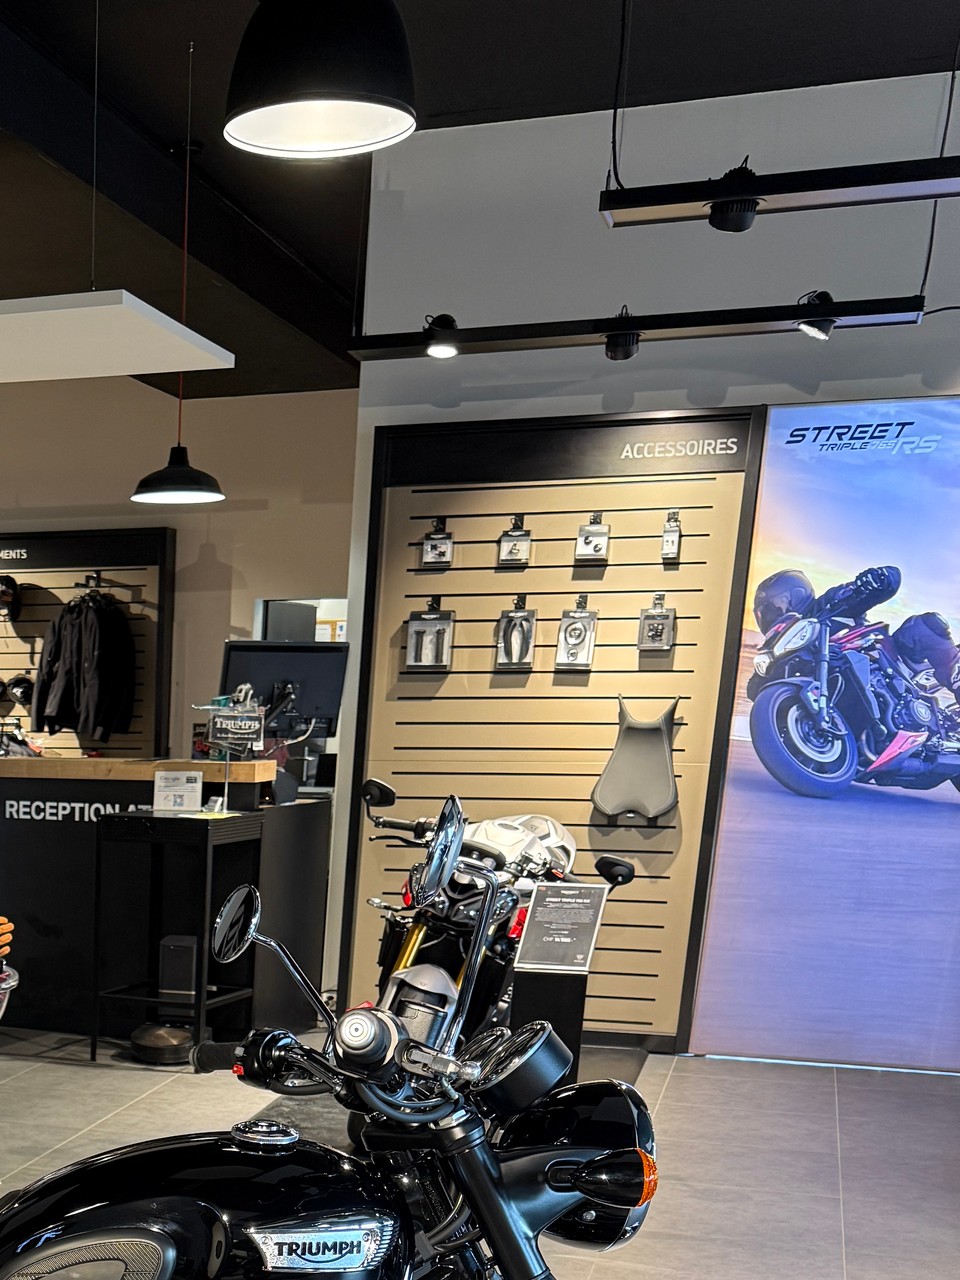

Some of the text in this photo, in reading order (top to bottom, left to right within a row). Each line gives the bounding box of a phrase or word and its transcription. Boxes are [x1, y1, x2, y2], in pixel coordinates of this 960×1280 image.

[785, 421, 915, 445] STREET
[620, 438, 738, 460] ACCESSOIRES
[819, 434, 943, 455] TRIPLE 765 RS
[214, 717, 260, 732] TRIUMPH
[5, 800, 120, 822] RECEPTION
[273, 1241, 362, 1263] TRIUMPH
